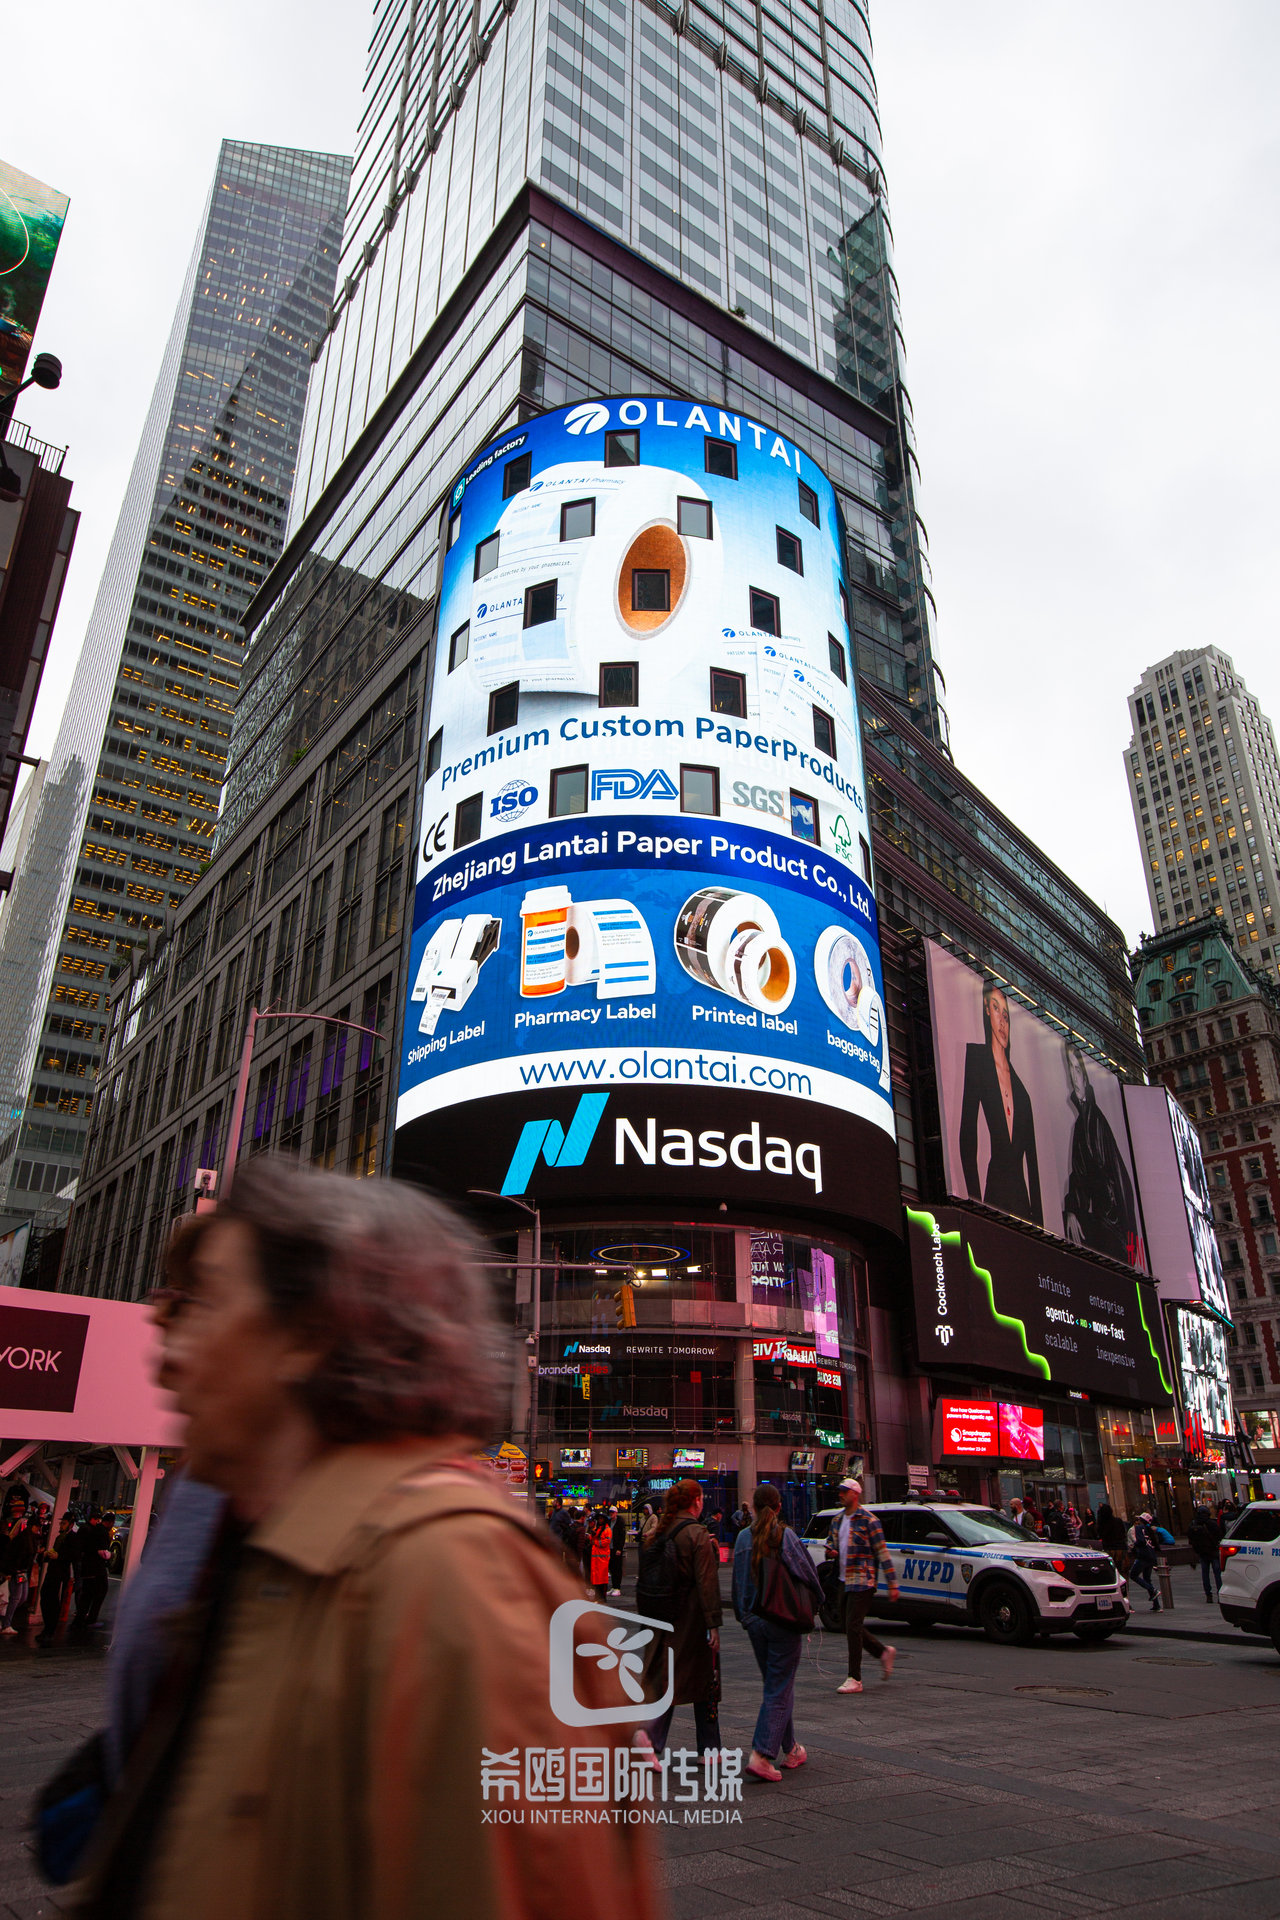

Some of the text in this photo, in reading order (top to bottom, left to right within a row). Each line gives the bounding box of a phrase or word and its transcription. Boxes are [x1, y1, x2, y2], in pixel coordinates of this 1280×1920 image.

[619, 400, 801, 475] OLANTAI
[465, 435, 526, 484] Leading factory
[545, 477, 590, 487] OLANTAI
[489, 597, 523, 613] OLANTA
[441, 728, 550, 791] Premium
[560, 715, 684, 741] Custom
[591, 768, 680, 801] FDA
[732, 781, 784, 818] SGS
[490, 786, 538, 818] ISO
[423, 812, 449, 862] CE
[834, 843, 853, 864] FSC
[432, 830, 872, 922] Zhejiang Lantai Paper Product Co., Ltd.
[514, 1003, 656, 1029] Pharmacy Label
[692, 1005, 798, 1036] Printed label
[407, 1020, 485, 1066] Shipping Label
[826, 1029, 881, 1074] baggage tag
[519, 1050, 812, 1096] www.olantai.com
[615, 1117, 822, 1195] Nasdaq
[931, 1223, 948, 1316] Cockroach Labs
[1038, 1274, 1071, 1298] infinite
[1089, 1295, 1125, 1317] enterprise
[1045, 1306, 1075, 1326] agentic
[1092, 1321, 1126, 1341] move-fast
[579, 1344, 716, 1355] Nasdaq REWRITE TOMORROW
[1045, 1333, 1078, 1353] scalable
[1096, 1345, 1136, 1368] inexpensive
[623, 1405, 668, 1420] Nasdaq
[962, 1429, 991, 1438] Snapdragon
[902, 1558, 955, 1583] NYPD
